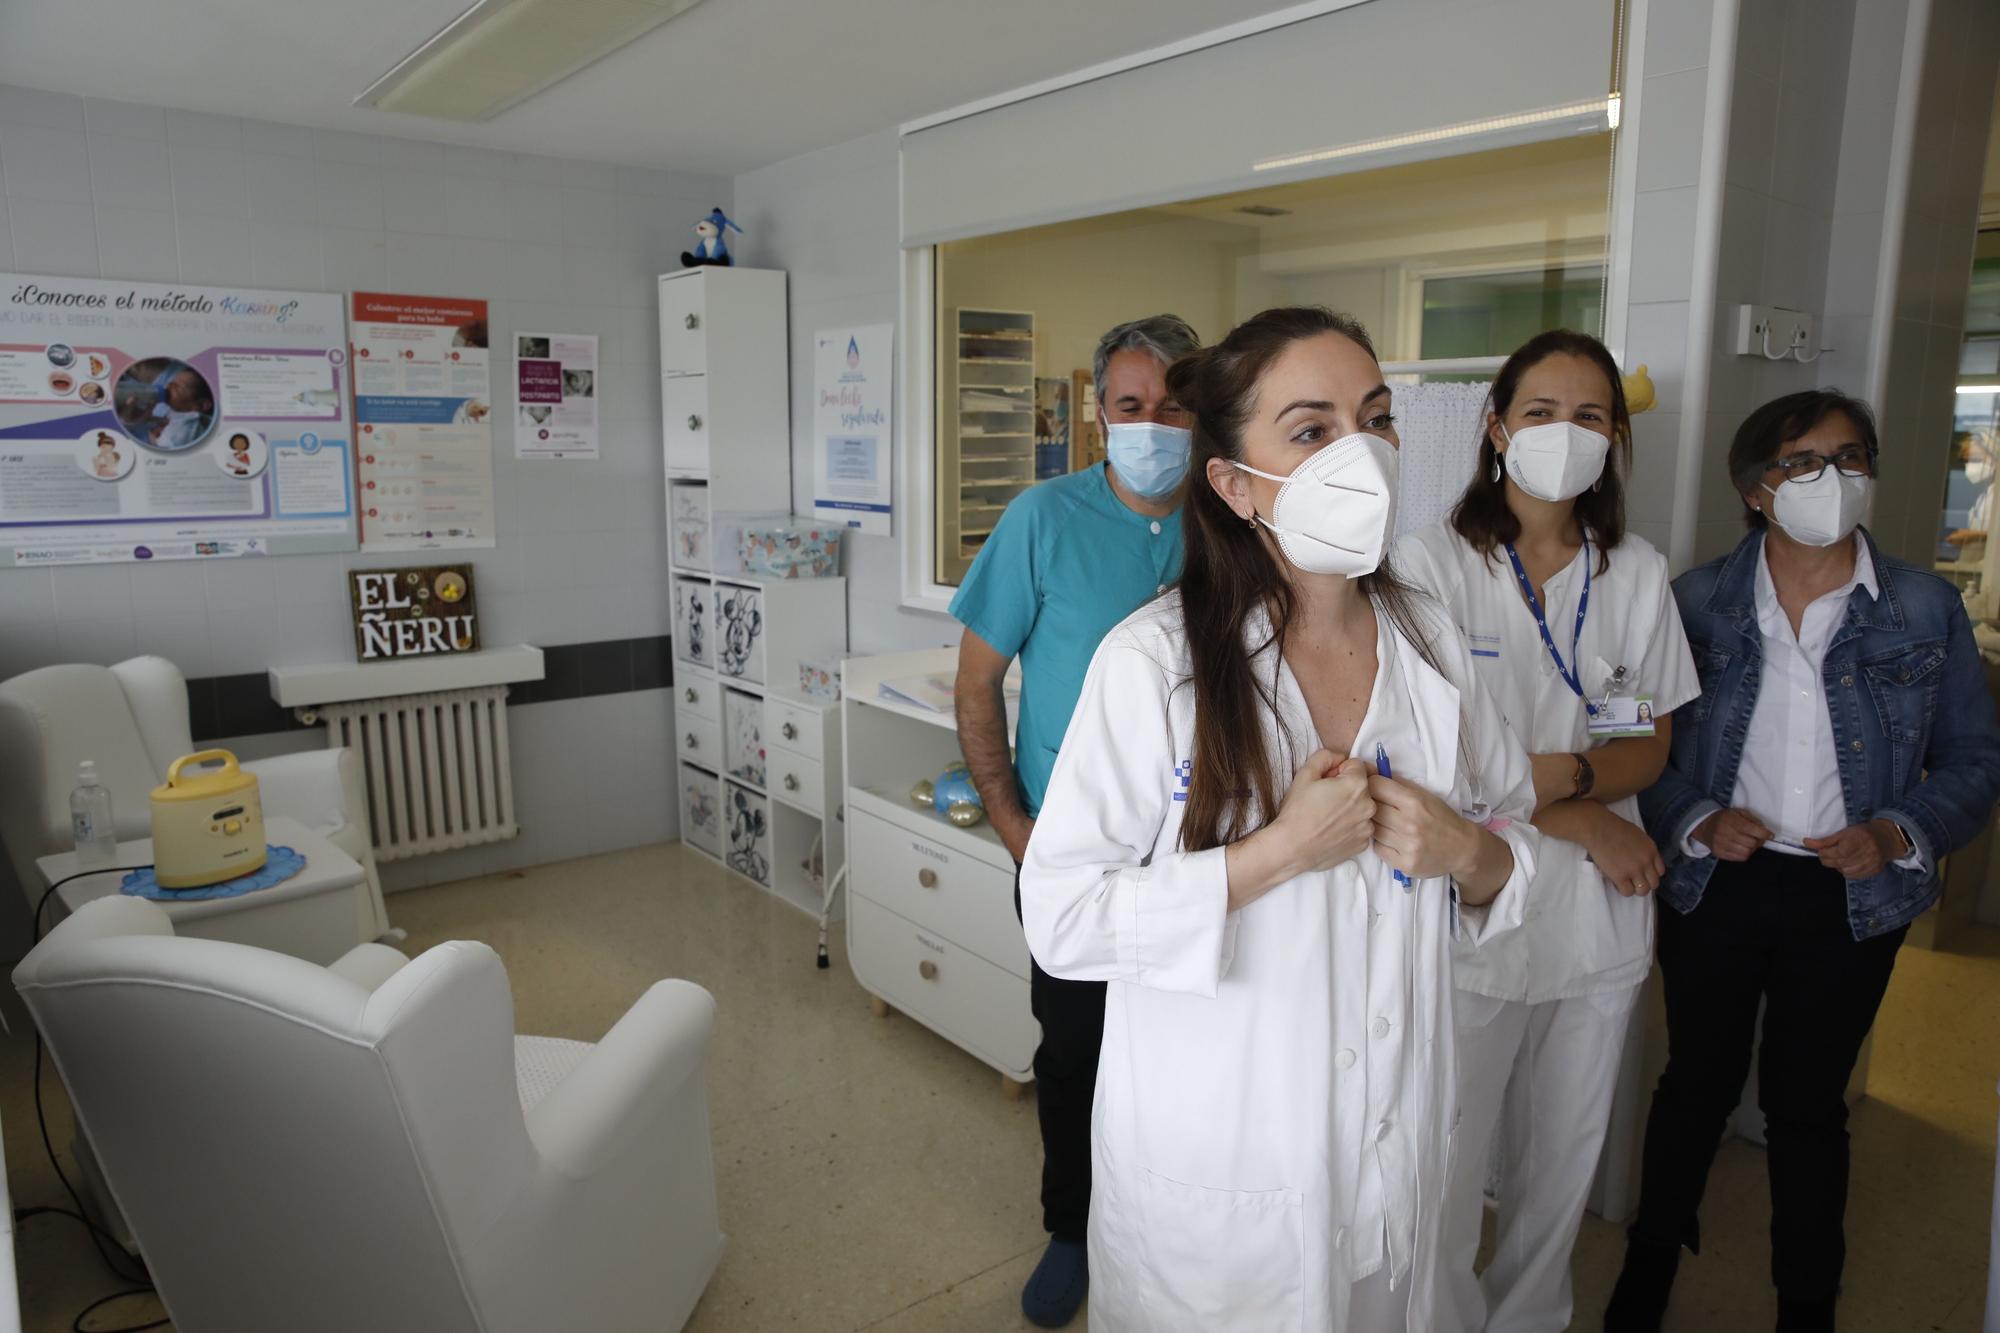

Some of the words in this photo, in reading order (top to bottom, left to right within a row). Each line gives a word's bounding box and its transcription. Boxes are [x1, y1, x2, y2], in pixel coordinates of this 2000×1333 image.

[12, 284, 107, 308] ¿Conoces
[115, 291, 135, 309] el
[140, 292, 213, 314] método
[219, 297, 299, 323] Kassing?
[356, 573, 411, 610] EL
[360, 612, 474, 658] ÑERU
